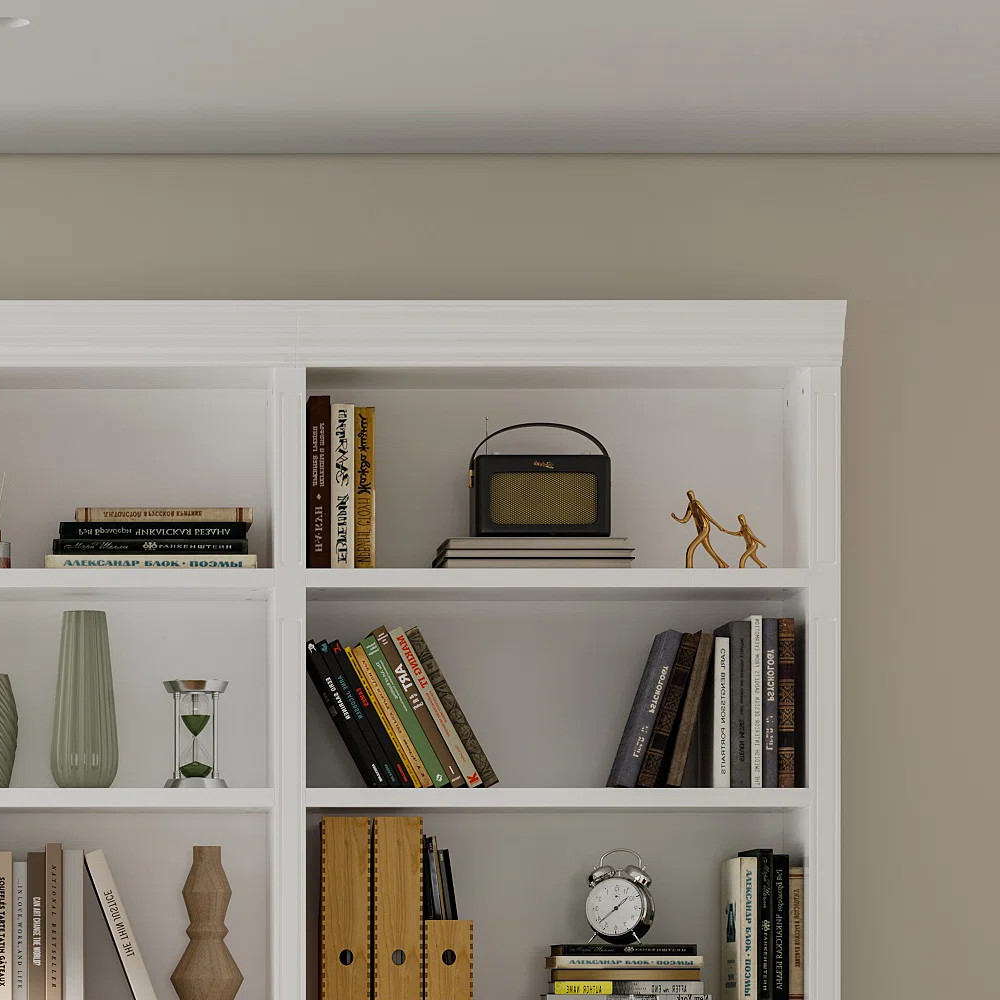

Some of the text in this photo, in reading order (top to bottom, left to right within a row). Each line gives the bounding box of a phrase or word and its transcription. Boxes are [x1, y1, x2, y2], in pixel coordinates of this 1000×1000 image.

[64, 559, 140, 568] АЛЕКСАНДР
[145, 559, 180, 568] БЛОК
[32, 896, 41, 907] CAN
[32, 908, 41, 917] ART
[32, 917, 41, 936] CHANGE
[32, 937, 41, 946] THE
